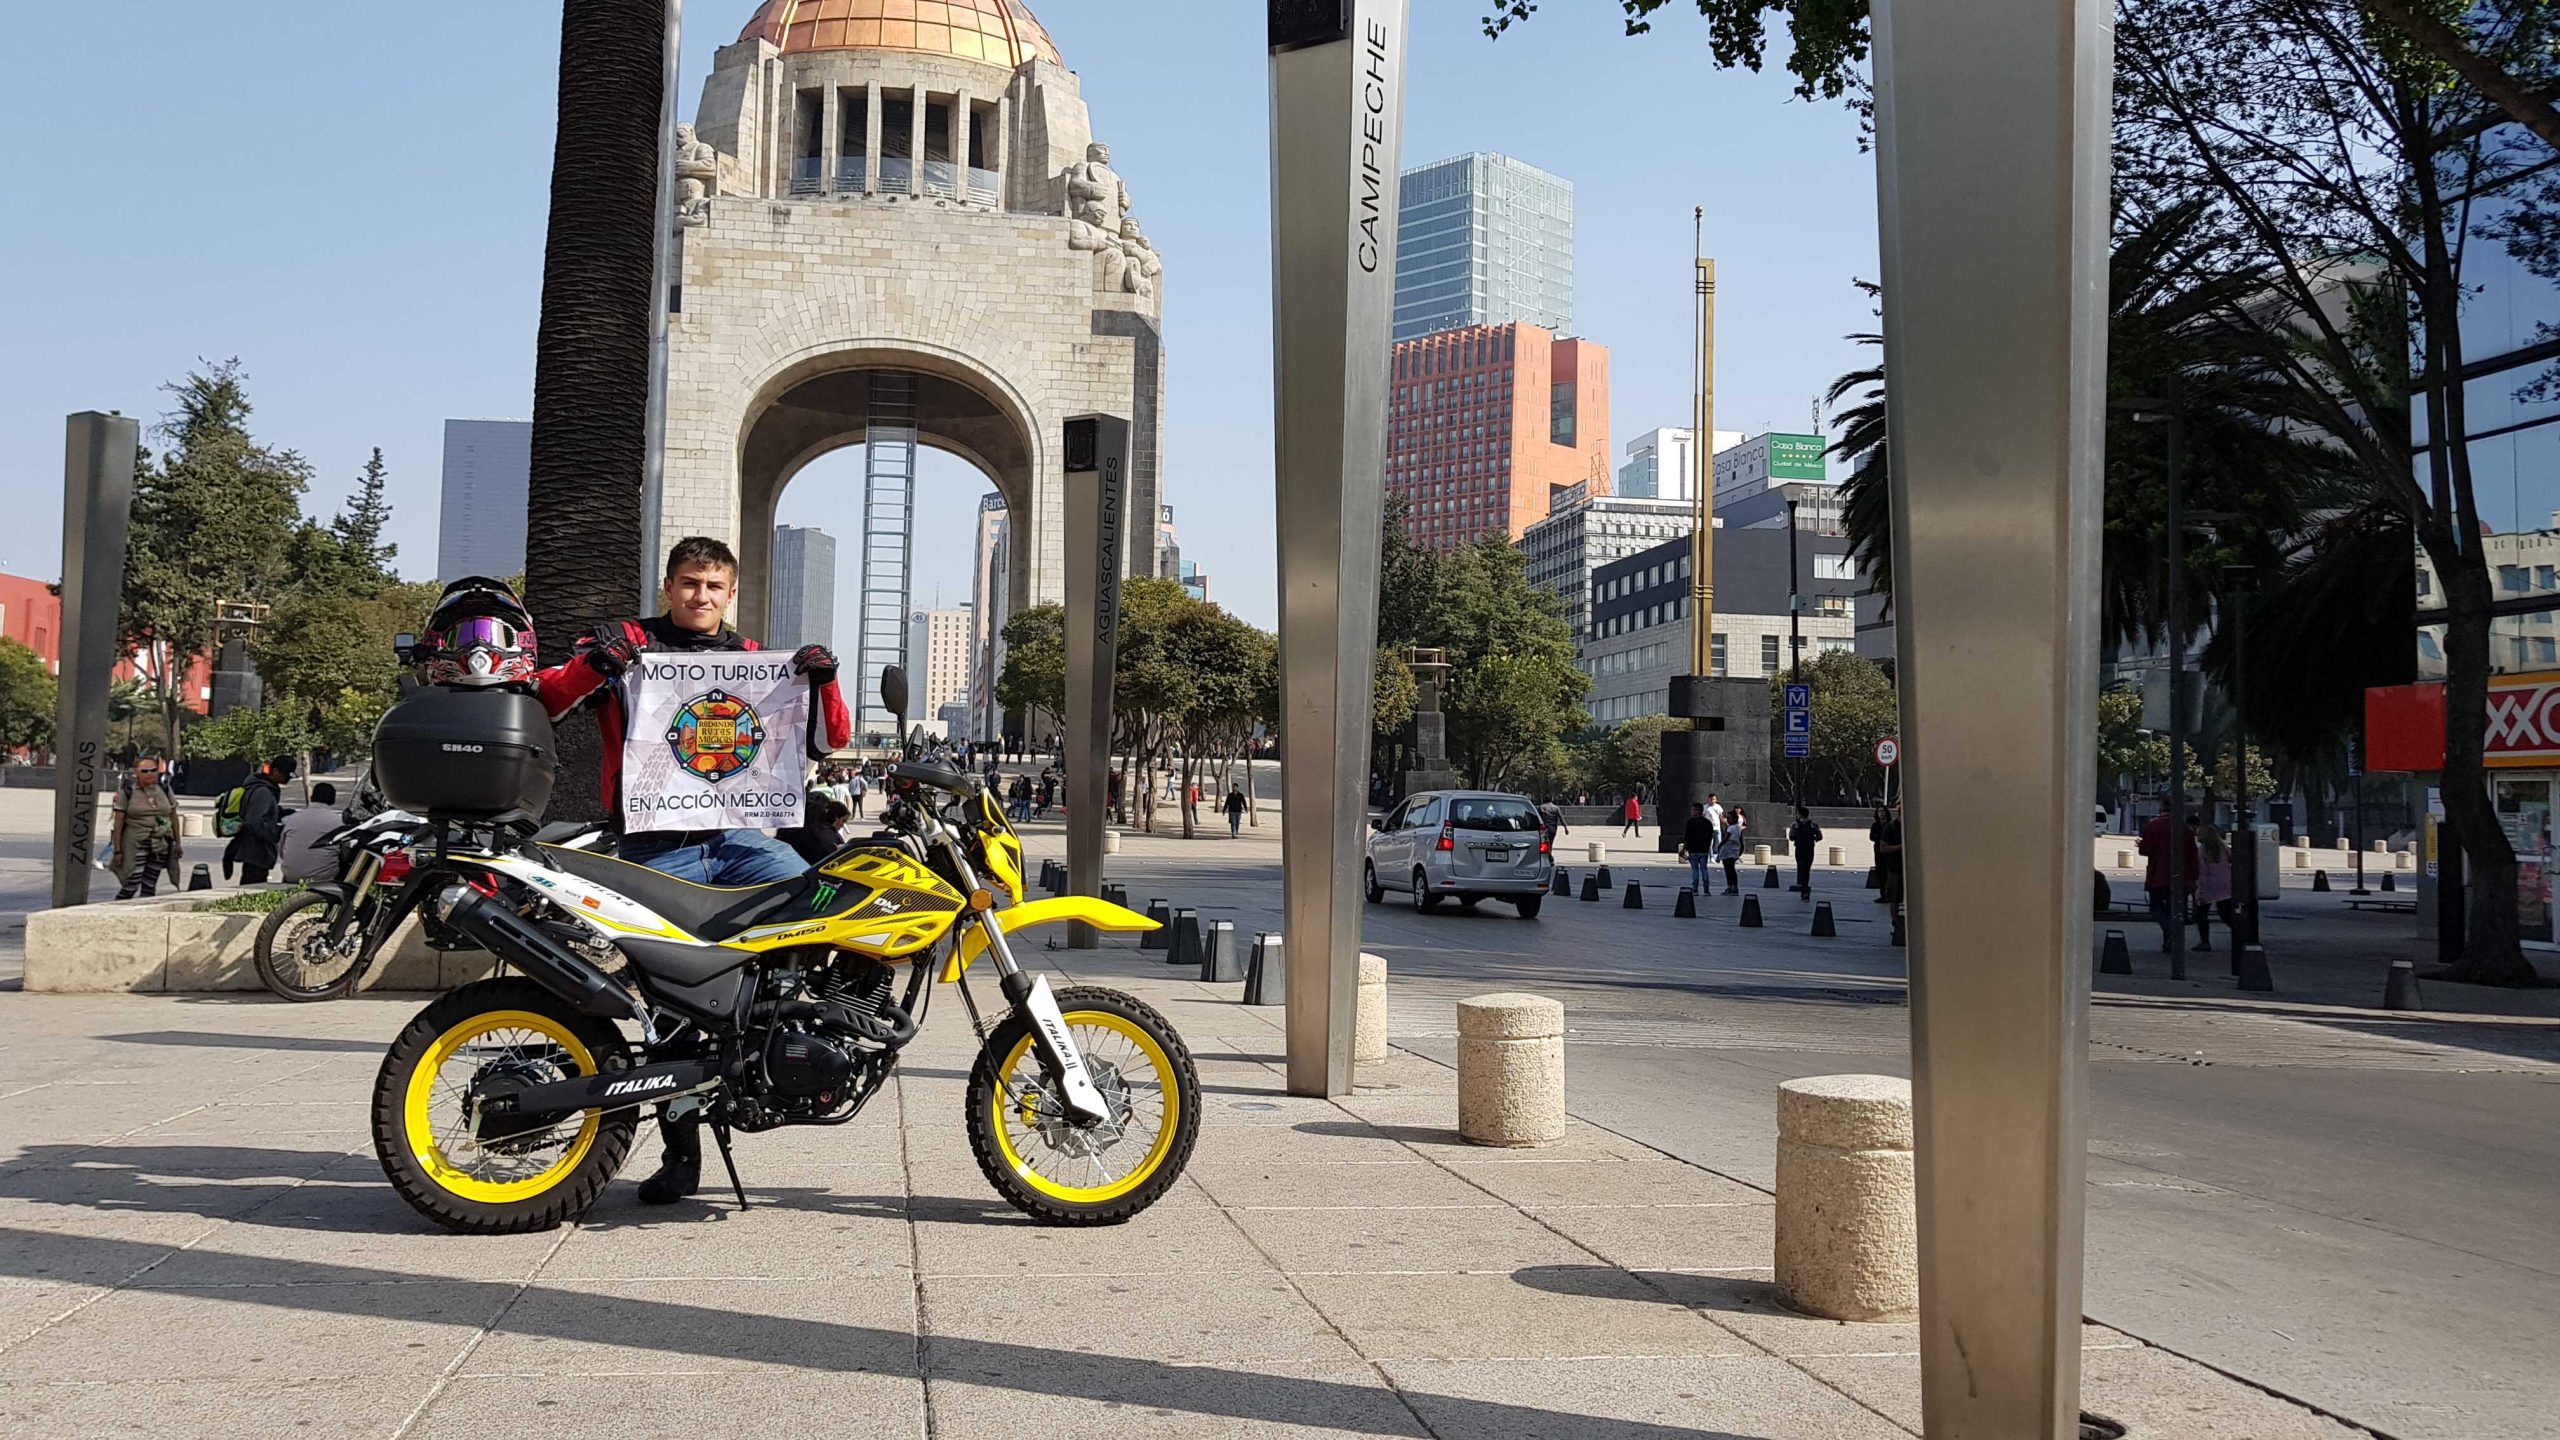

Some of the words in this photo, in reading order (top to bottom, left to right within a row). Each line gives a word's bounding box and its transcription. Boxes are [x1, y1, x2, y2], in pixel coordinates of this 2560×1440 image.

[1358, 17, 1387, 273] CAMPECHE
[1771, 440, 1794, 450] Casa
[1796, 442, 1822, 452] Blanca
[1712, 459, 1731, 477] asa
[1733, 446, 1765, 469] Blanca
[982, 497, 1006, 511] Barce
[1098, 456, 1118, 645] AGUASCALIENTES
[642, 664, 706, 682] MOTO
[711, 664, 790, 682] TURISTA
[712, 692, 722, 700] N
[1788, 692, 1806, 707] M
[1789, 711, 1805, 731] E
[2483, 688, 2560, 747] XX
[442, 743, 484, 753] SH40
[1882, 745, 1893, 754] 50
[710, 772, 719, 780] S
[70, 741, 97, 865] ZACATECAS
[629, 797, 652, 813] EN
[656, 790, 726, 810] ACCIÓN
[730, 789, 797, 808] MÉXICO
[874, 897, 901, 911] DM
[777, 925, 827, 941] DM150
[1042, 1018, 1072, 1058] ITALIKA
[604, 1074, 675, 1097] ITALIKA
